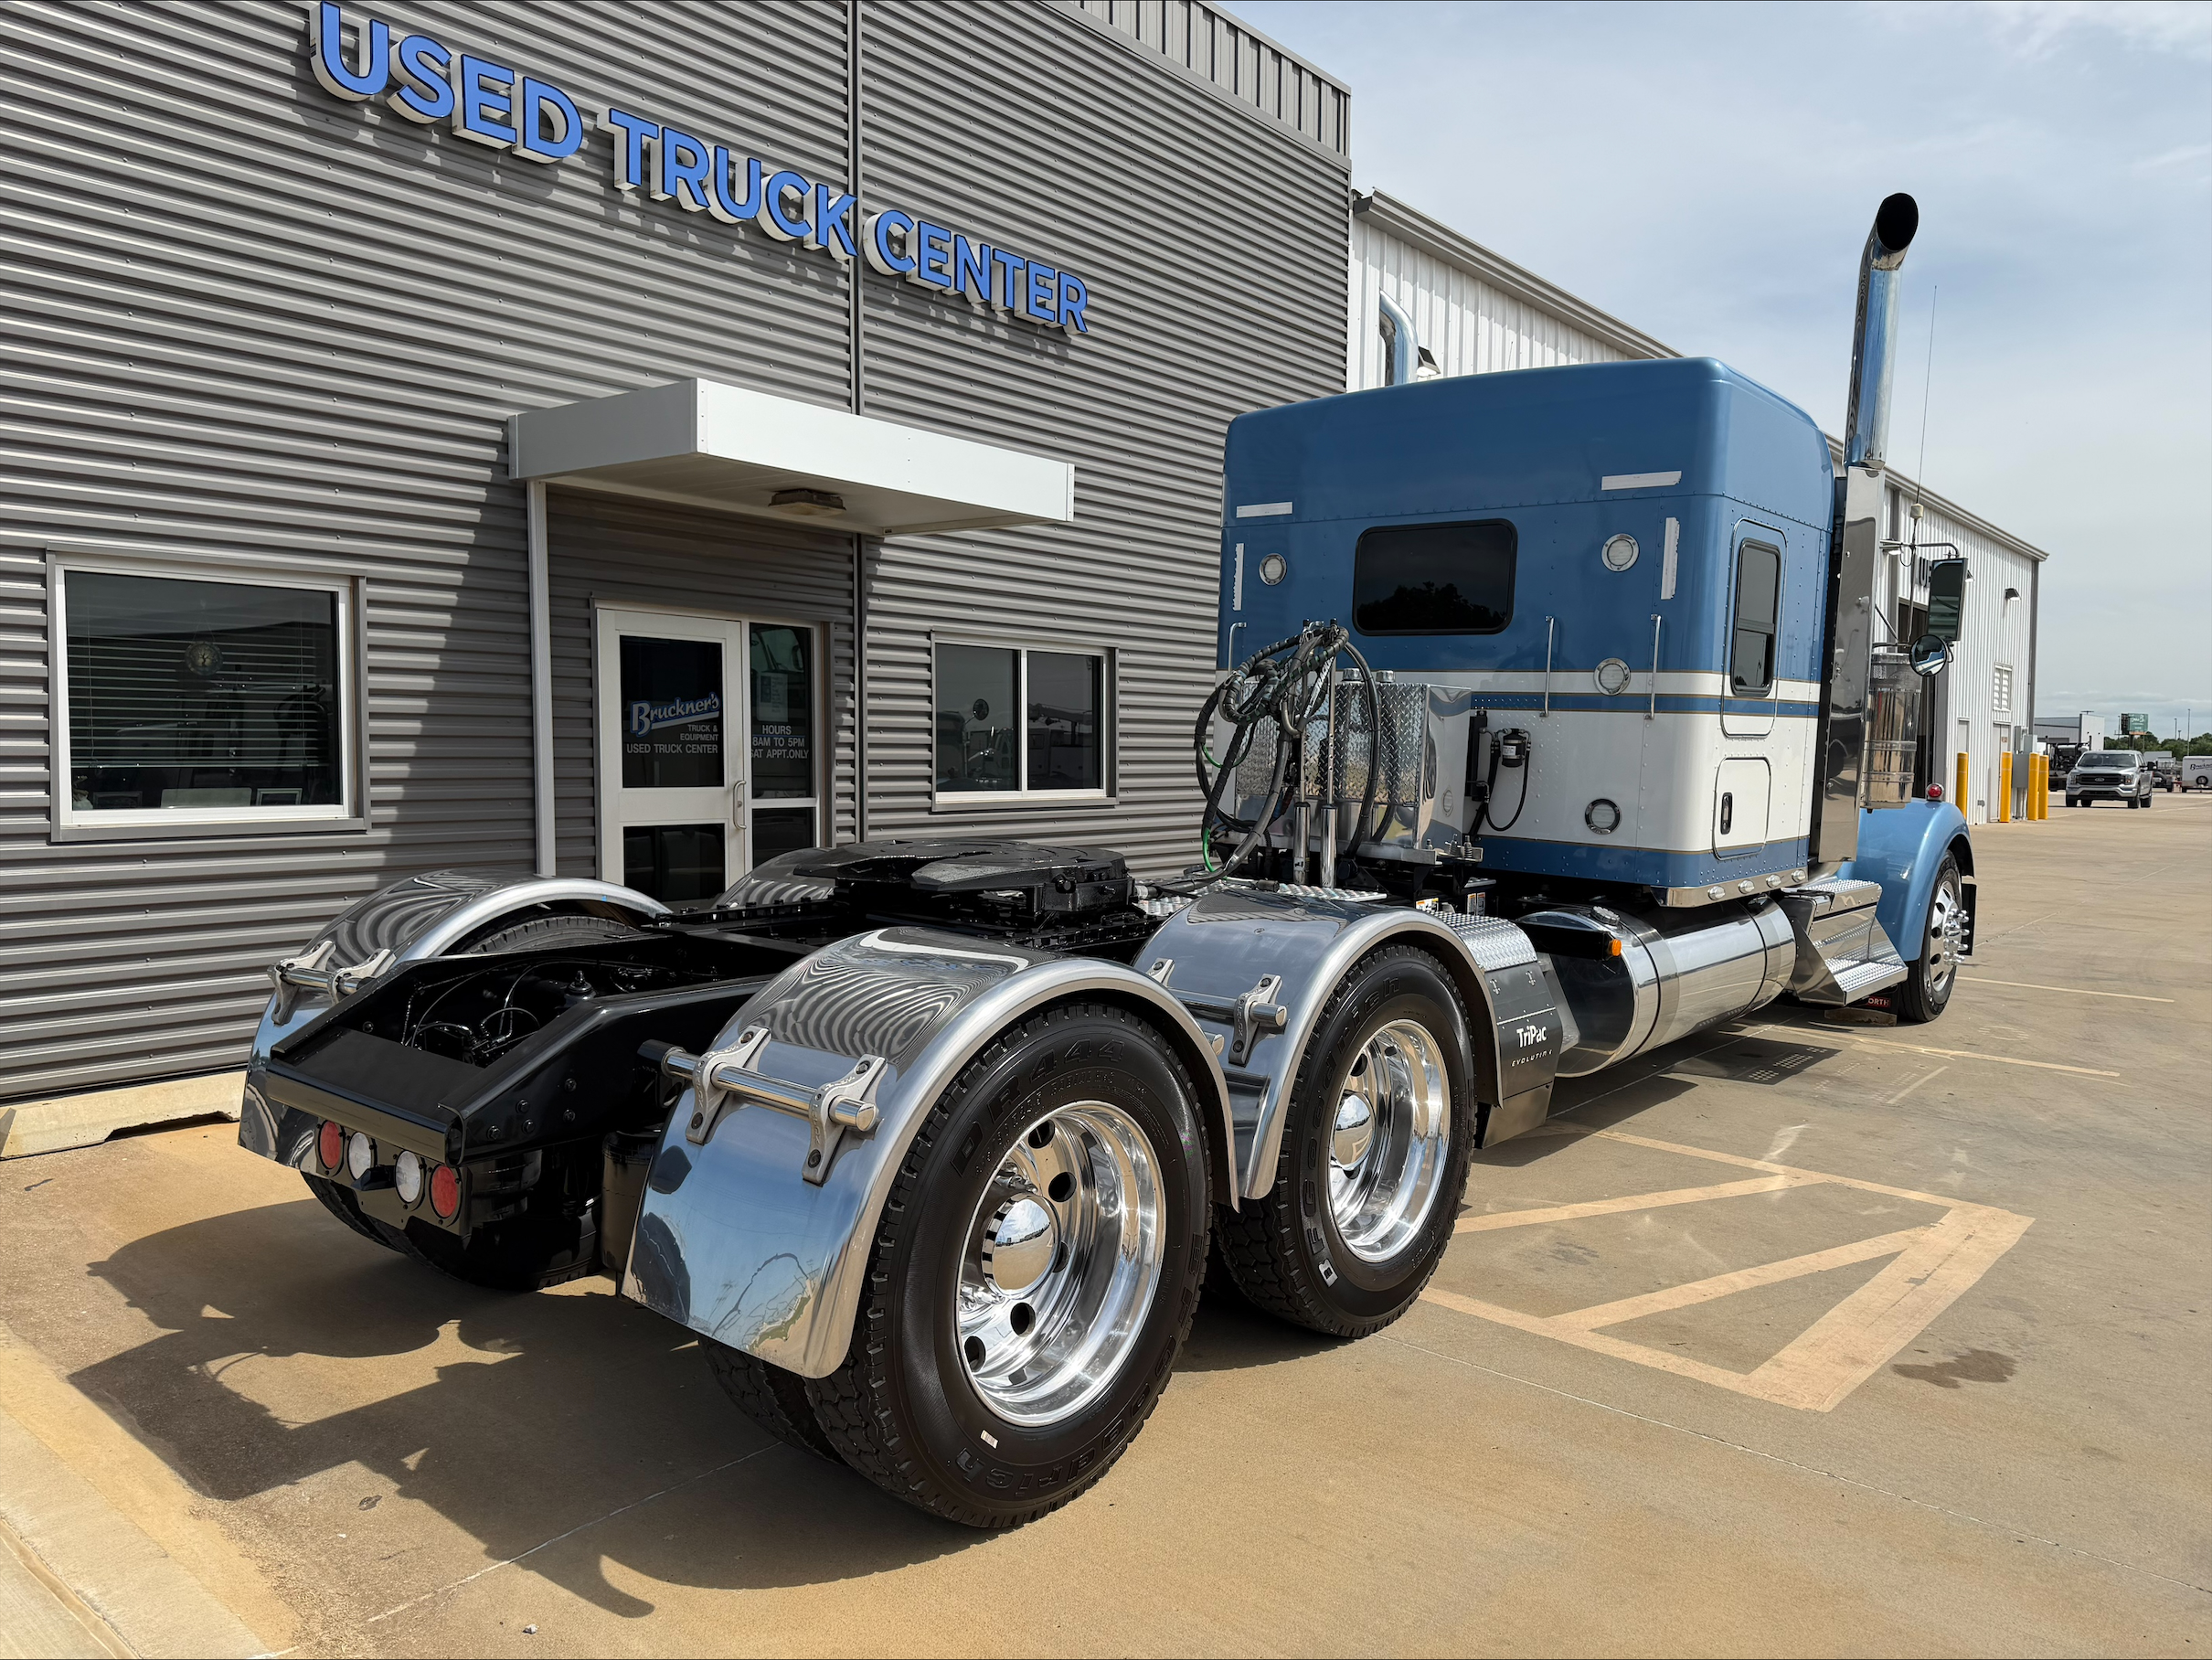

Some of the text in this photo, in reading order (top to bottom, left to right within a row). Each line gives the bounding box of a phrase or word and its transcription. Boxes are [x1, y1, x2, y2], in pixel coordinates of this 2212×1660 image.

[316, 0, 1090, 335] USED TRUCK CENTER
[631, 692, 720, 737] Bruckner's
[687, 724, 710, 732] TRUCK
[762, 725, 792, 735] HOURS
[680, 733, 718, 741] EQUIPMENT
[752, 736, 805, 748] 8AM TO 5PM
[626, 743, 718, 754] USED TRUCK CENTER
[1867, 997, 1890, 1006] ORTH
[1516, 1025, 1547, 1048] TriPac
